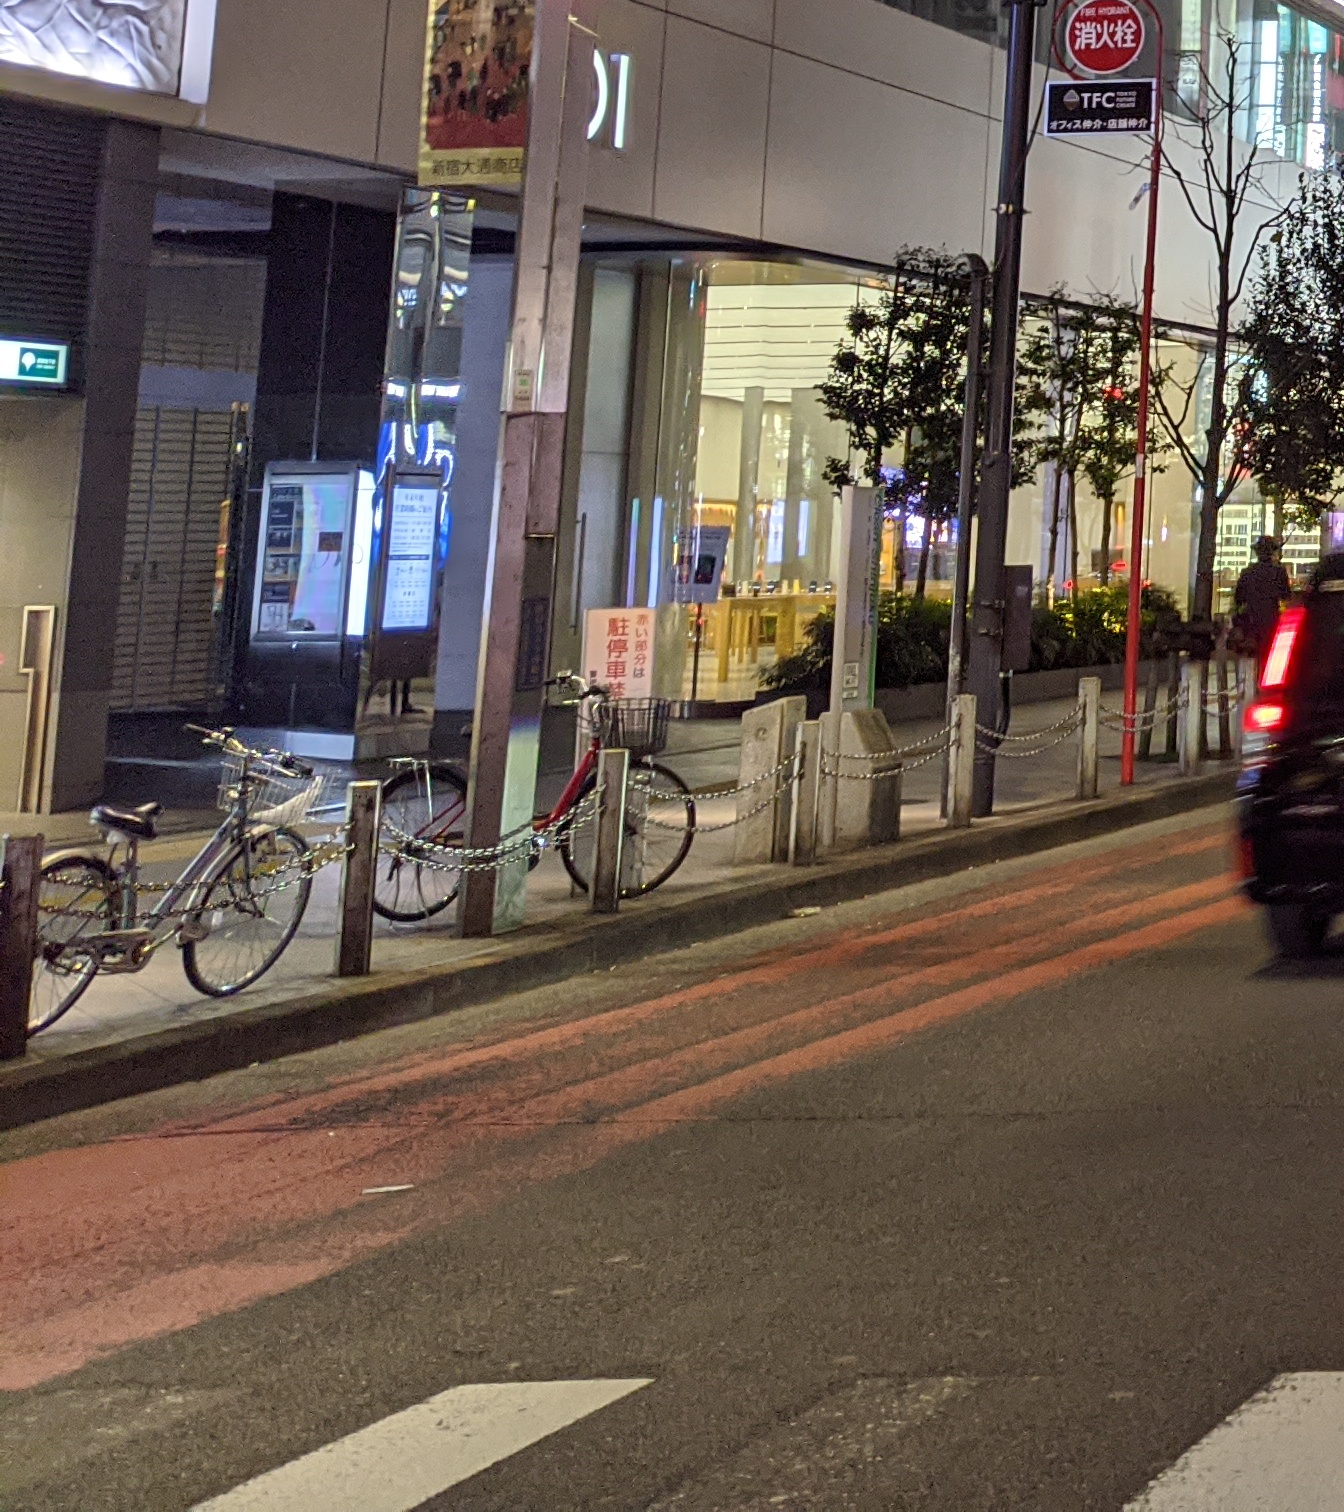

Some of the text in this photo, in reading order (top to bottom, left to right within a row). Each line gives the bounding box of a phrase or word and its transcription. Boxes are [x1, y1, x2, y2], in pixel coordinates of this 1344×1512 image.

[1080, 5, 1130, 17] FIRE HYDRANT
[1074, 19, 1138, 50] 消火栓
[1080, 92, 1115, 109] TFC
[633, 614, 649, 679] 赤い部分は
